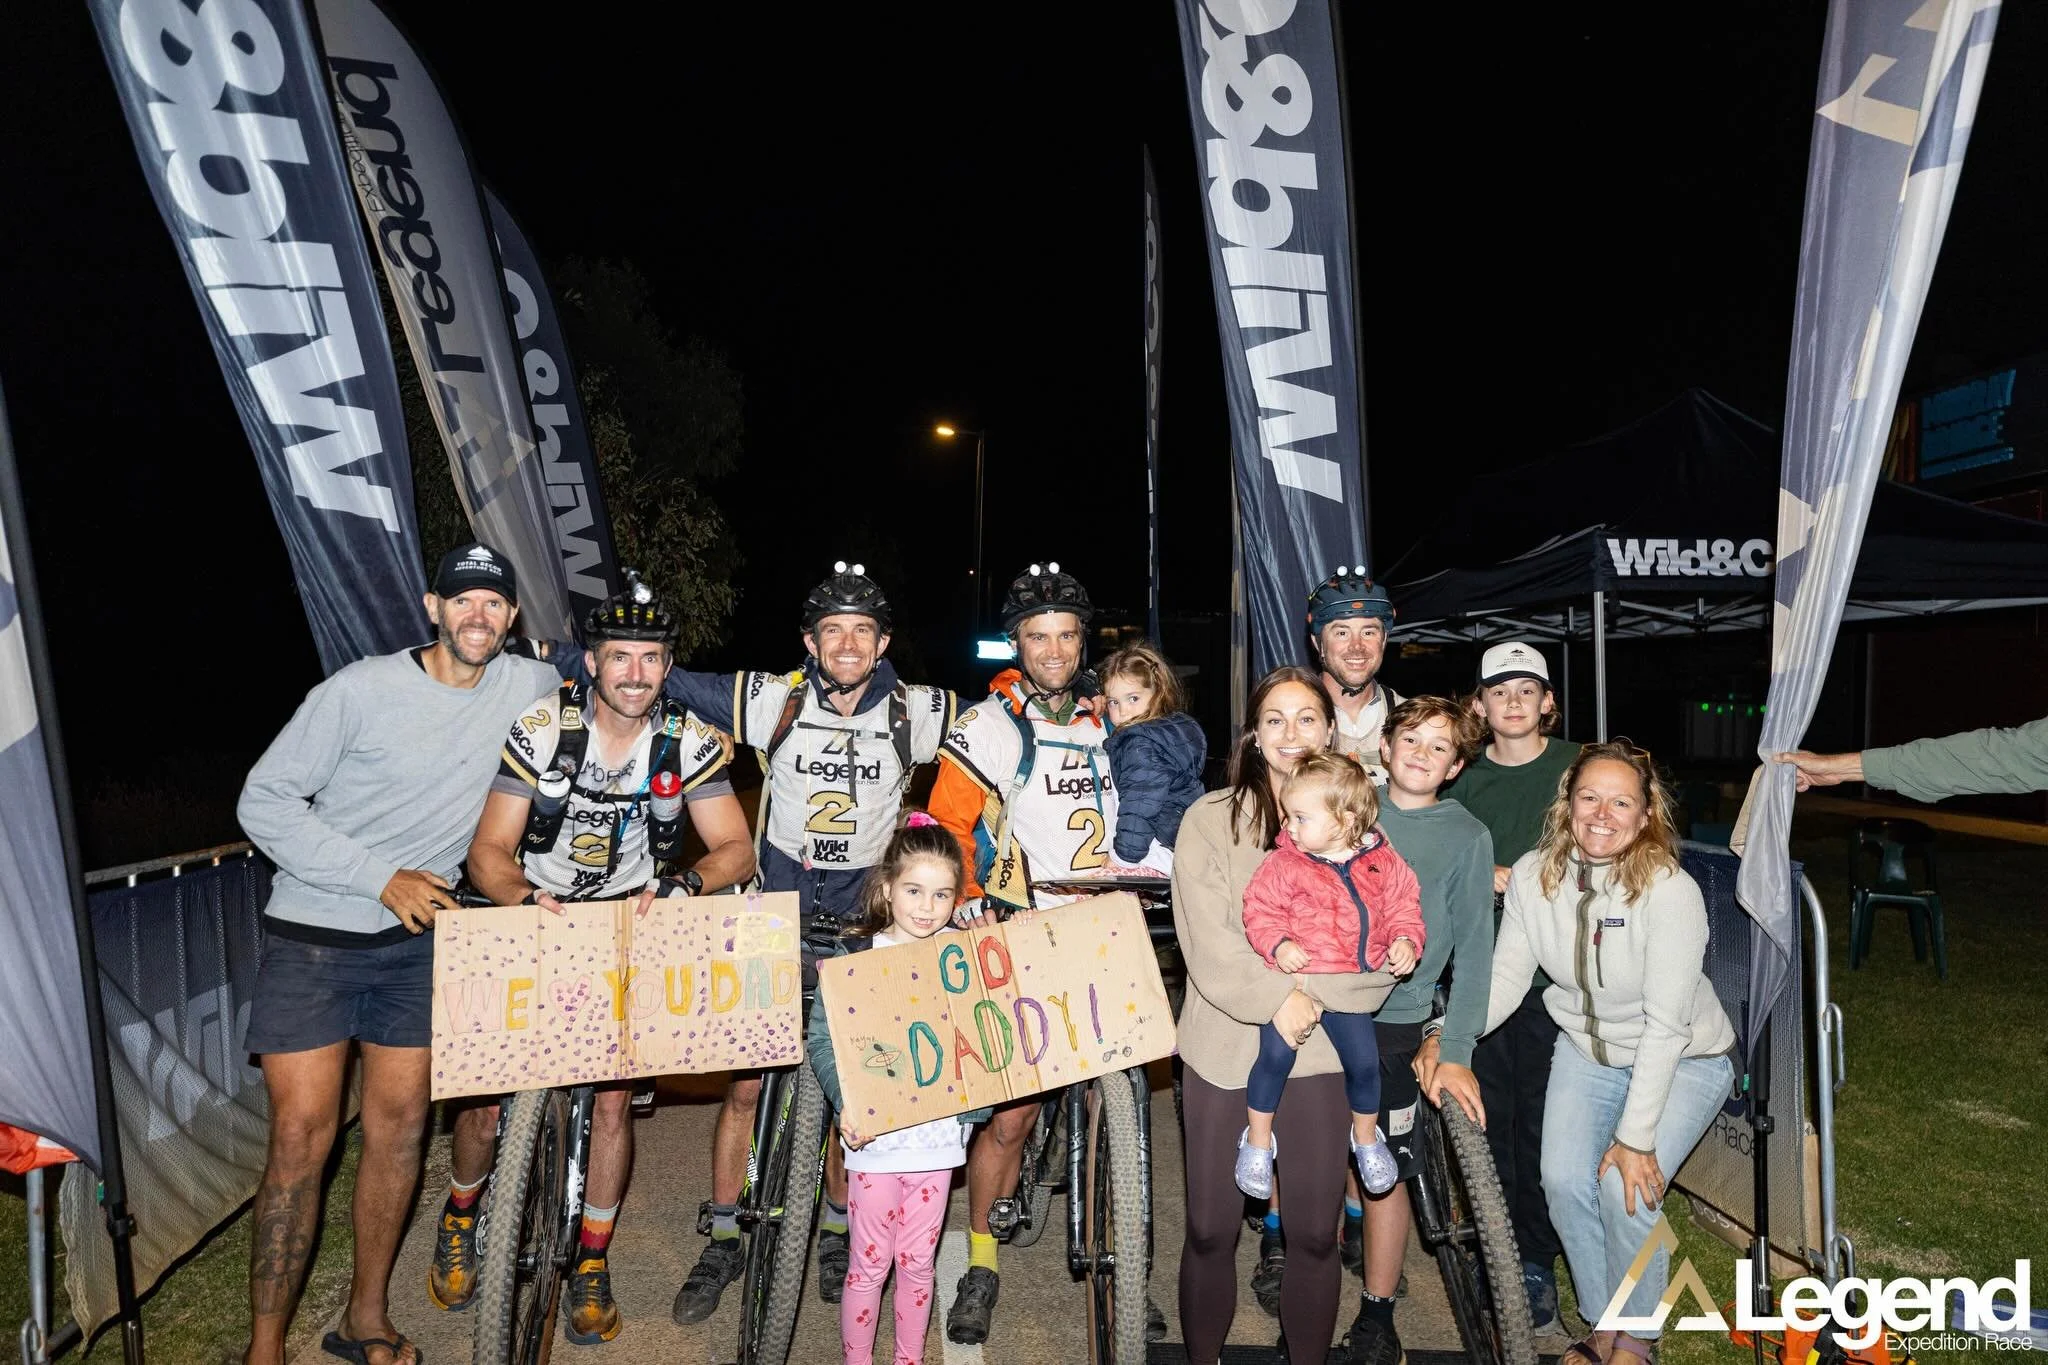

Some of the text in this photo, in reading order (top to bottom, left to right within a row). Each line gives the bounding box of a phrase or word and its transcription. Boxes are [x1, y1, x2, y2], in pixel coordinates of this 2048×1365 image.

[520, 708, 551, 735] 2
[795, 754, 881, 782] Legend
[803, 790, 858, 834] 2
[812, 850, 850, 863] &Co.
[813, 838, 849, 853] Wild
[1067, 807, 1109, 871] 2
[939, 935, 1014, 995] GO
[442, 957, 800, 1035] WE YOU DAD
[908, 983, 1103, 1088] DADDY!
